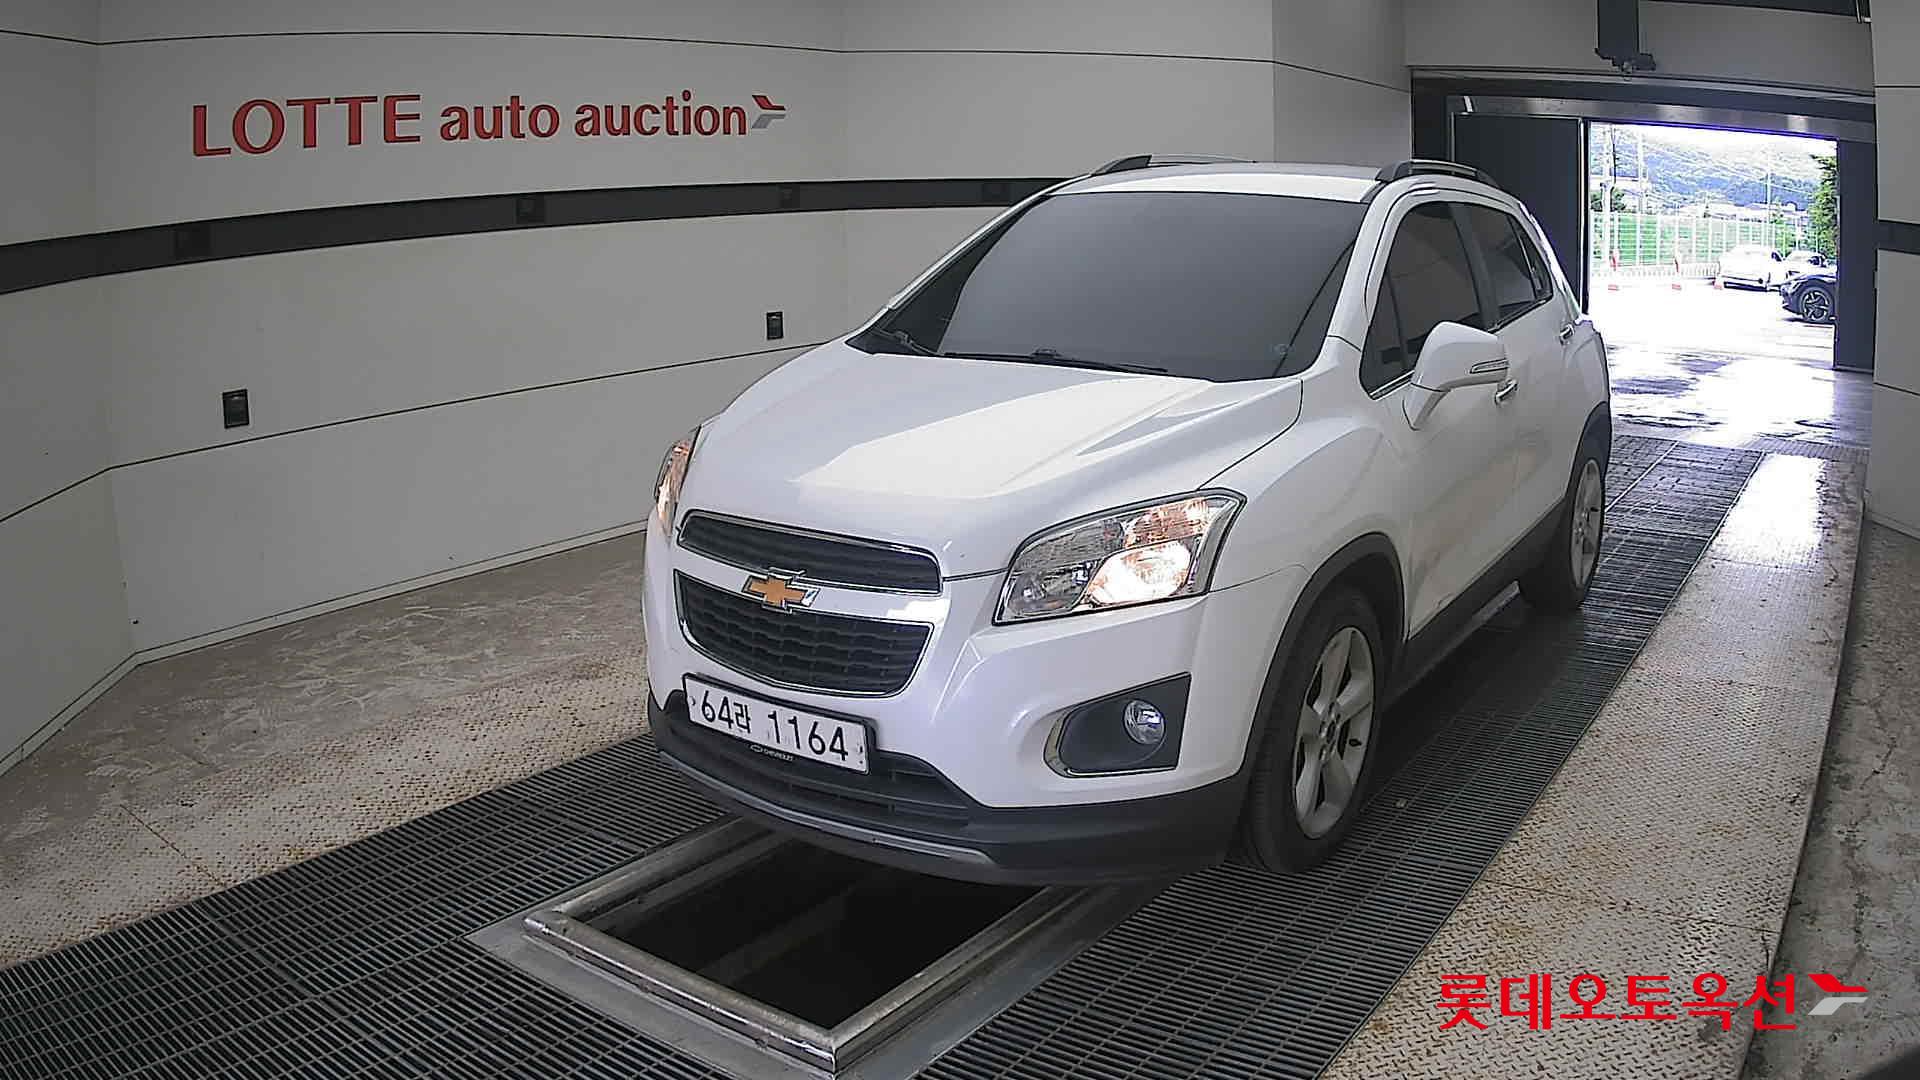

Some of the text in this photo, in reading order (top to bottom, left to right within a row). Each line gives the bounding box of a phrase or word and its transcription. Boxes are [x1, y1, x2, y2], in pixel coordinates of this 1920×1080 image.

[193, 89, 747, 157] LOTTE auto auction
[701, 689, 849, 762] 64라 1164
